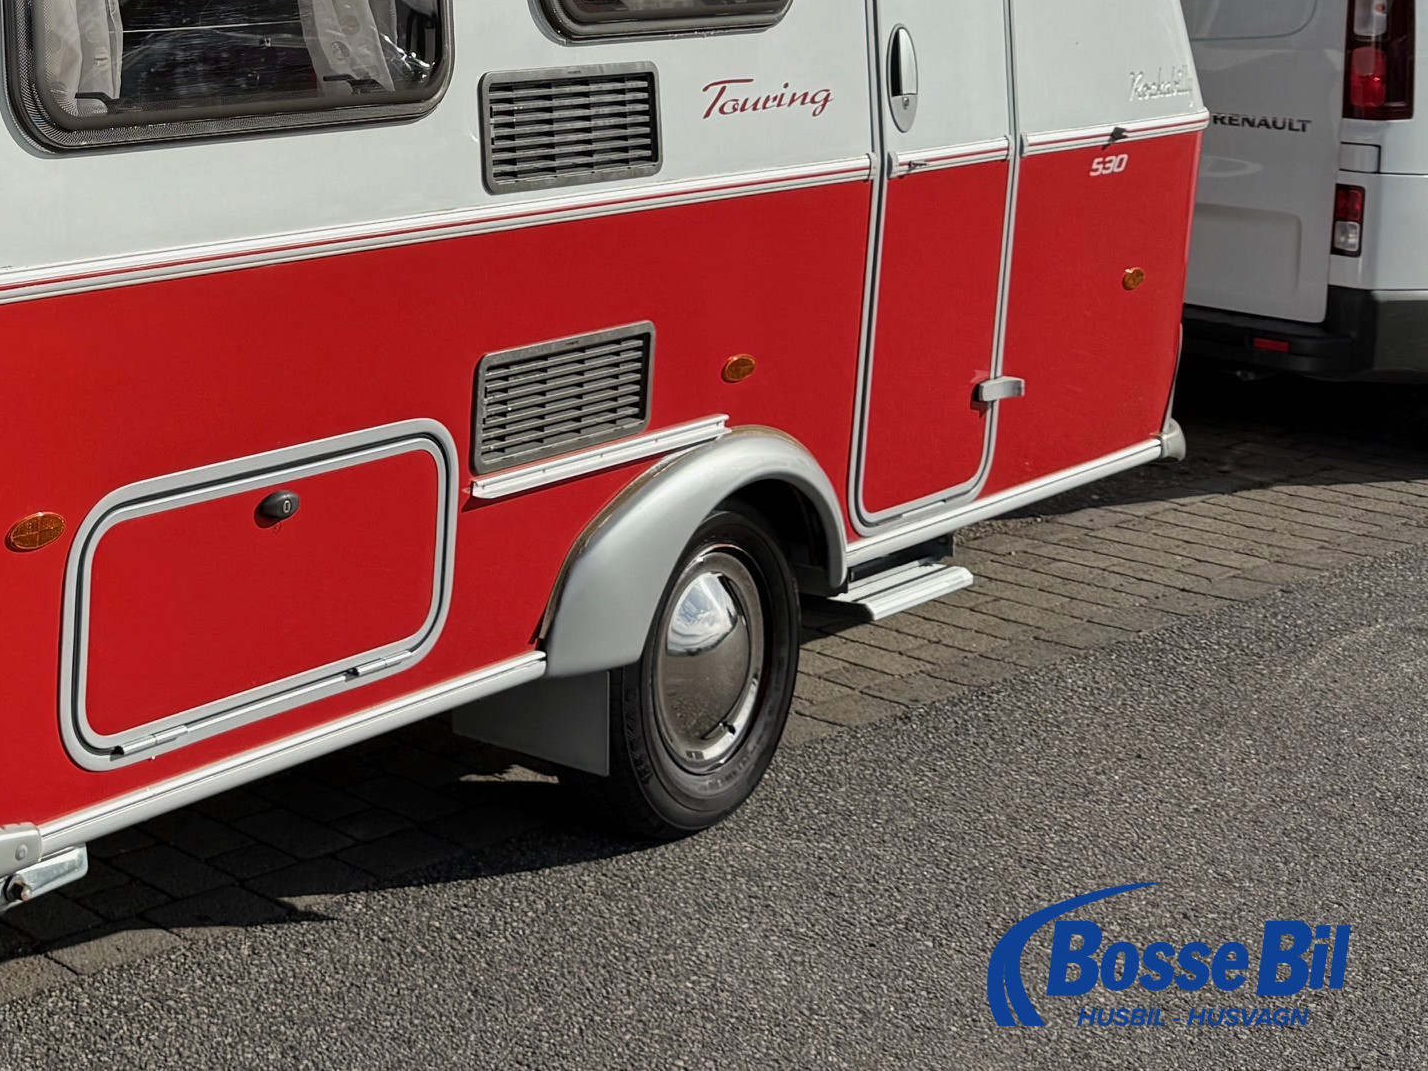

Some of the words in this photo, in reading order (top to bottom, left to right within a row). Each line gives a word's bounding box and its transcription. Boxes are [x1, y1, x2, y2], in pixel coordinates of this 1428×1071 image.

[702, 78, 834, 119] Touring
[1212, 113, 1312, 133] RENAULT
[1089, 153, 1129, 177] 530
